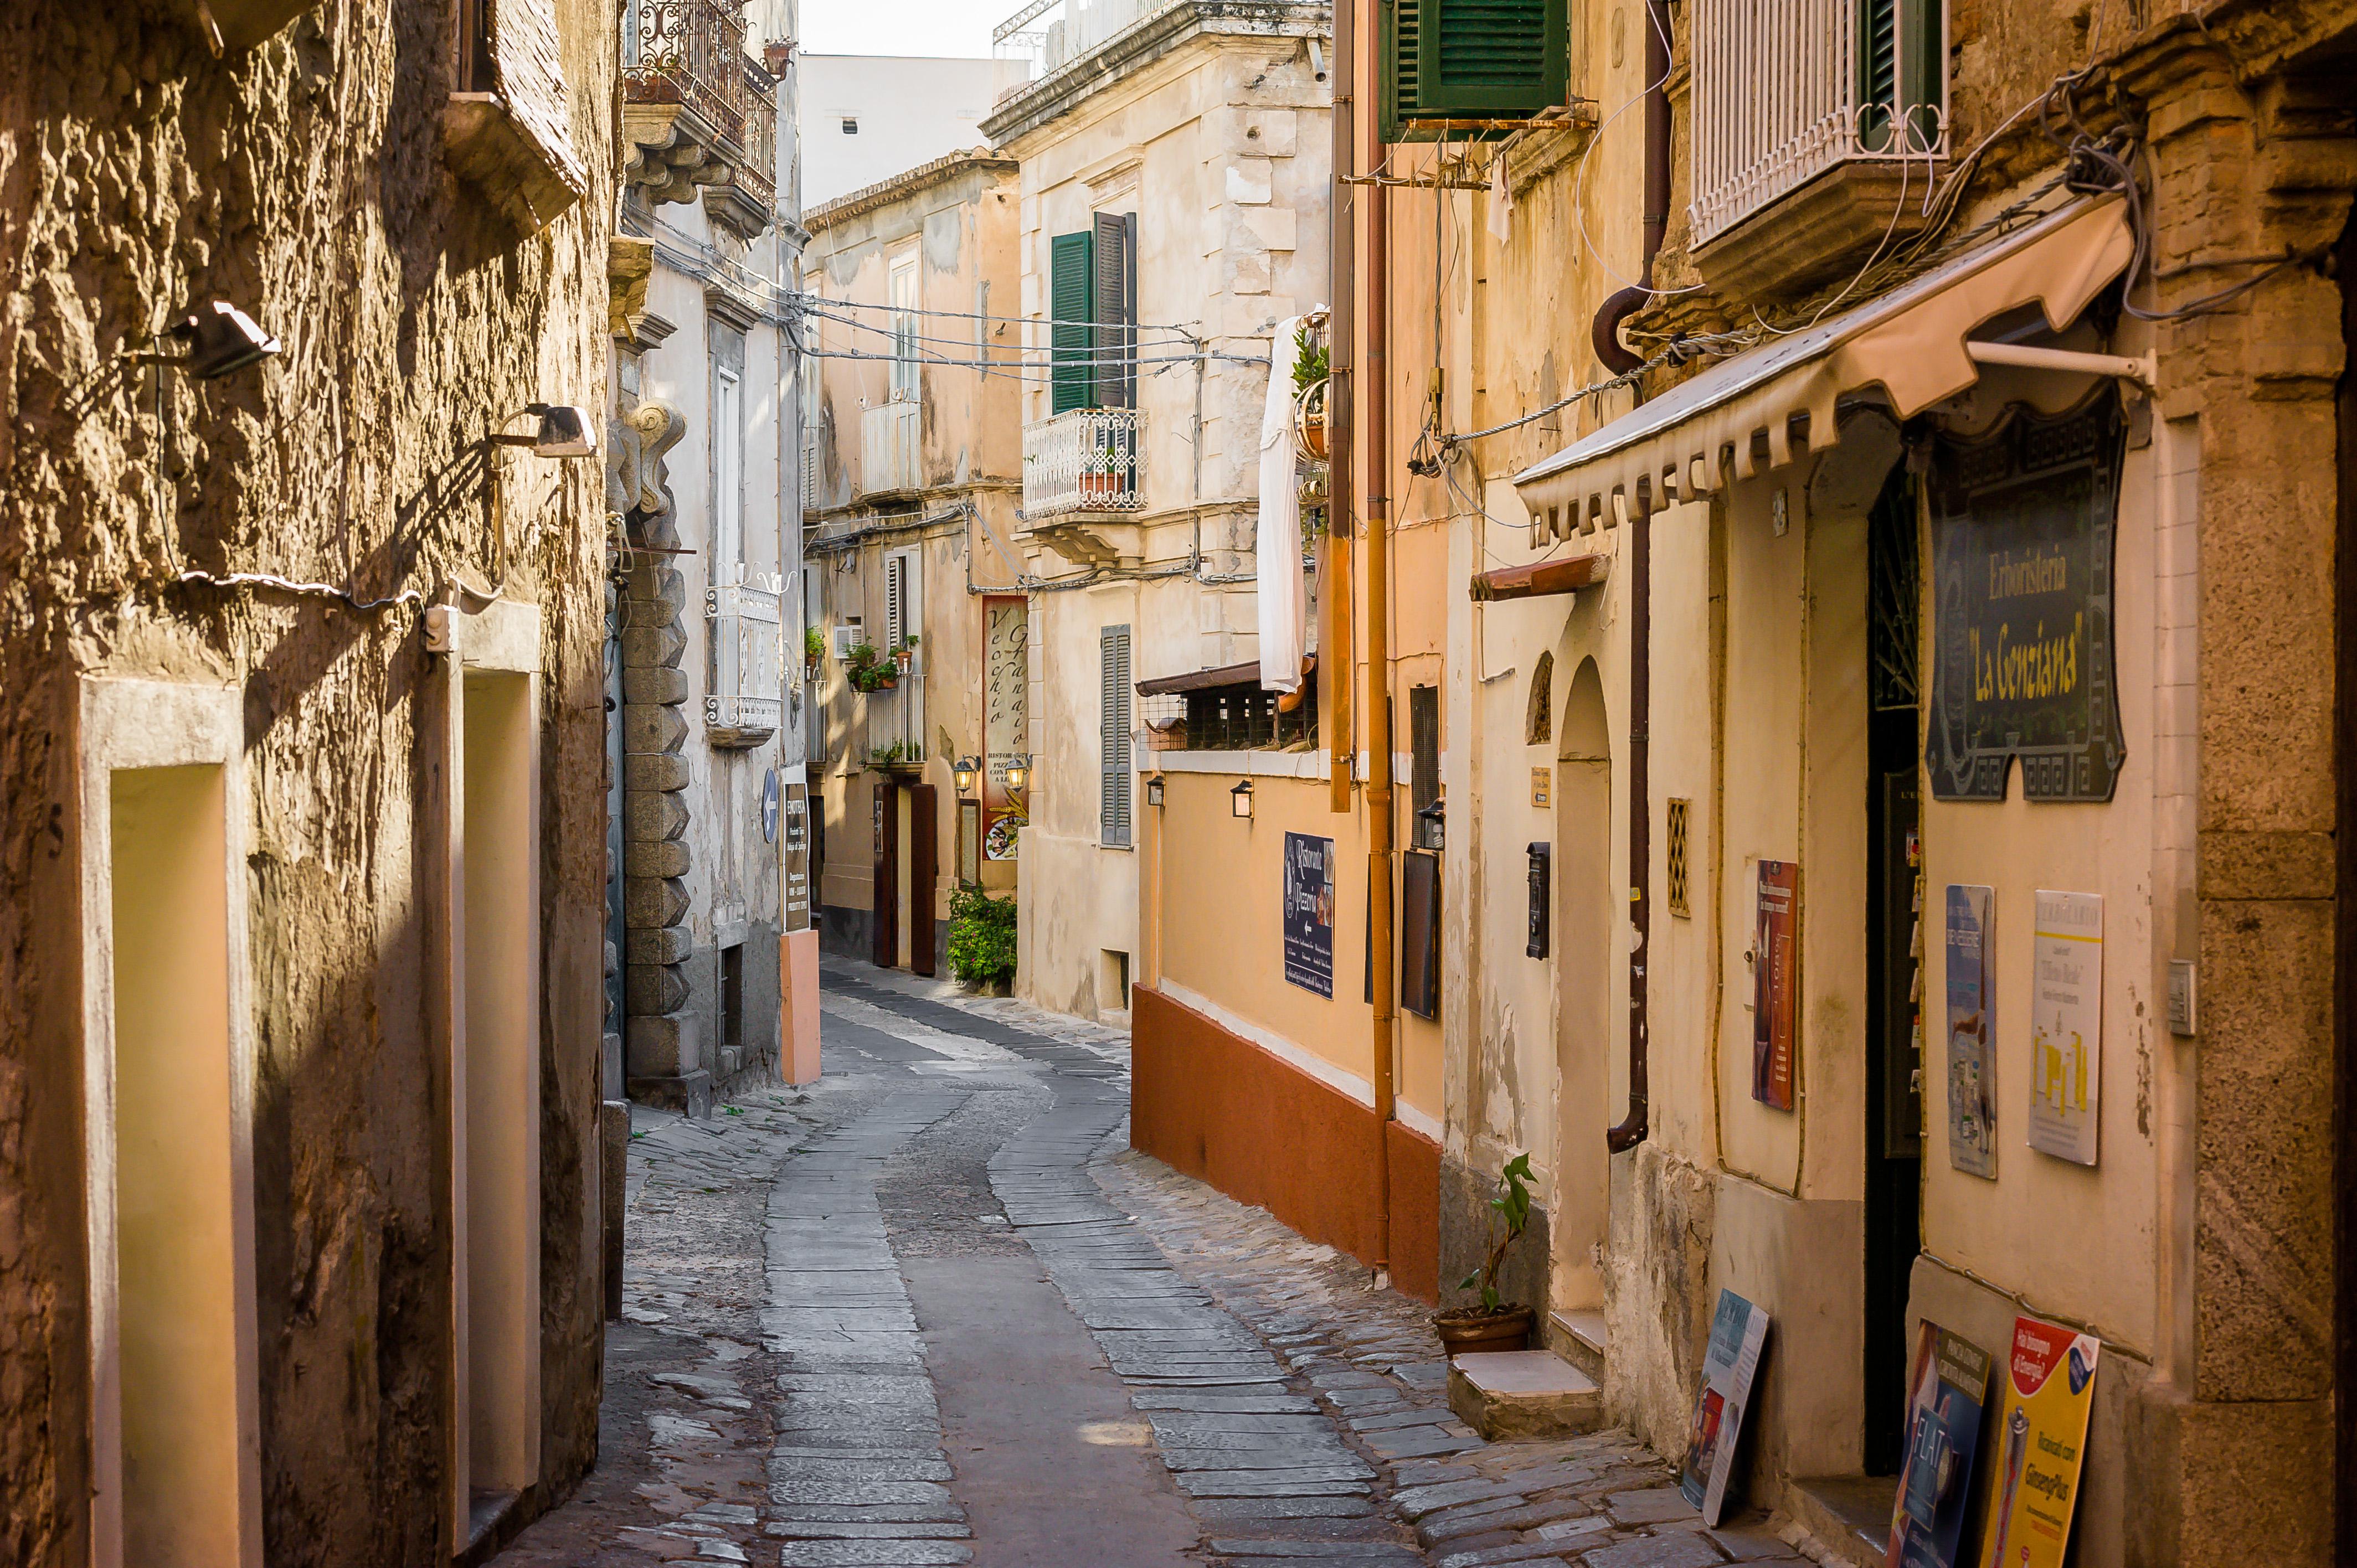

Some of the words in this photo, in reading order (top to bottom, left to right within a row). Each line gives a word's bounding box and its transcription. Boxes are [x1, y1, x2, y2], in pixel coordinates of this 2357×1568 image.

[1989, 544, 2066, 600] Erboristeria
[1010, 624, 1028, 745] Granaio
[787, 800, 806, 815] ENOTECA
[1296, 839, 1322, 880] Ristorante
[1295, 882, 1317, 921] Pizzeria
[1914, 1417, 1946, 1468] FLAT
